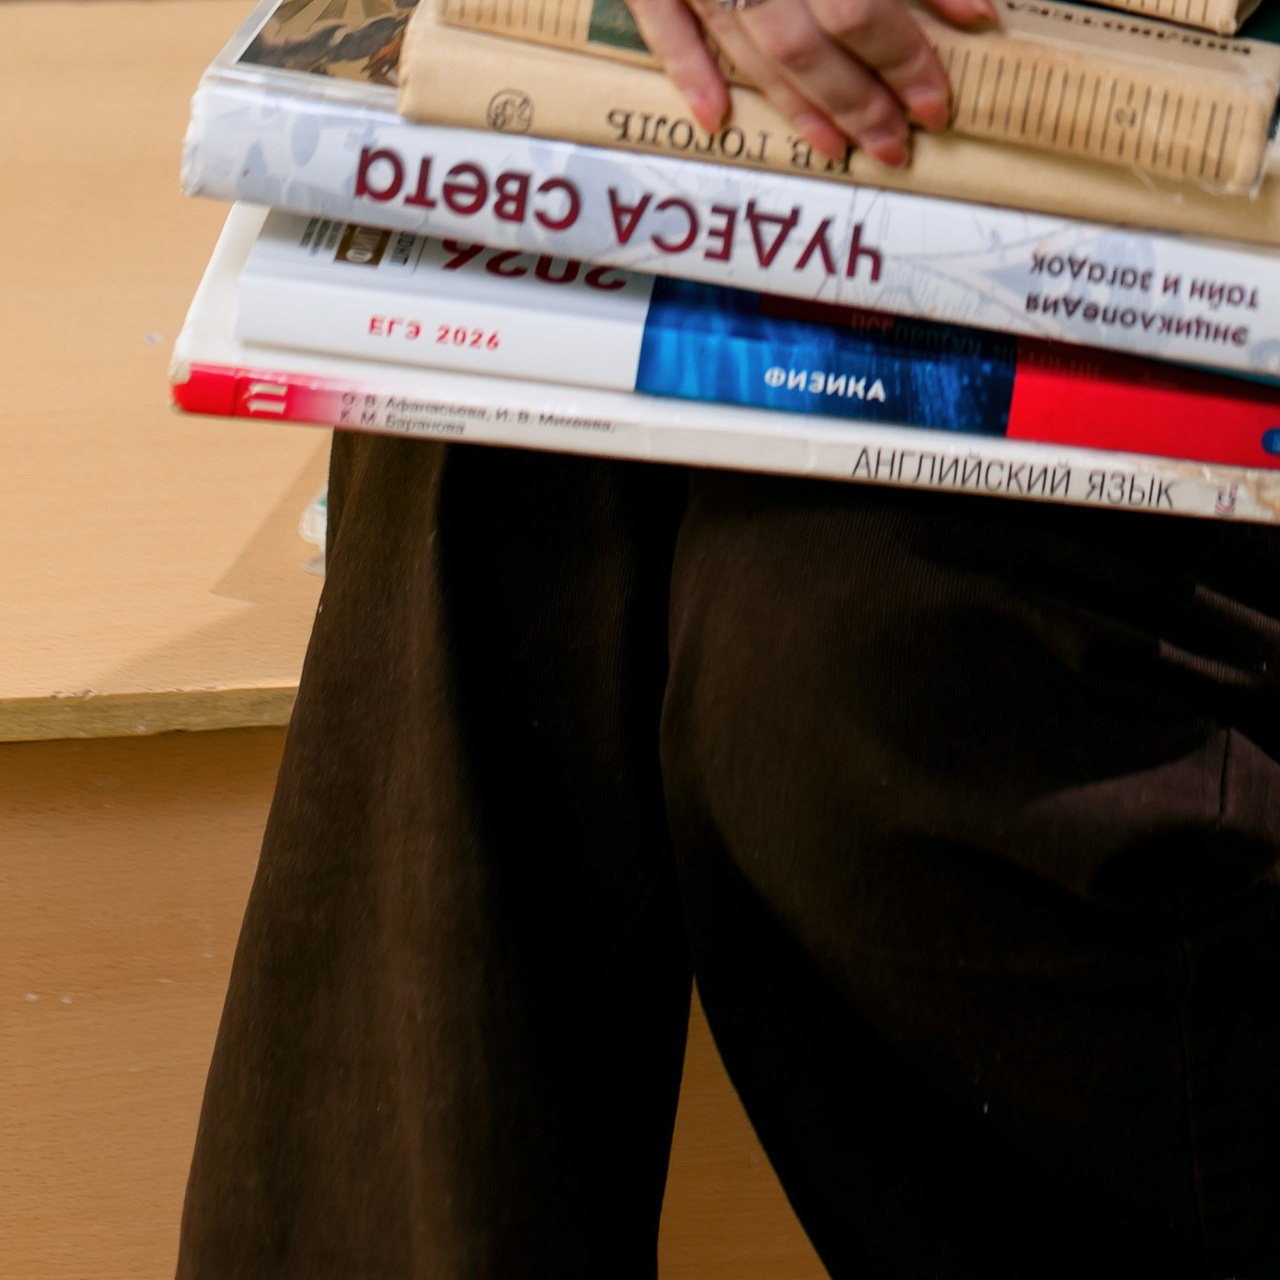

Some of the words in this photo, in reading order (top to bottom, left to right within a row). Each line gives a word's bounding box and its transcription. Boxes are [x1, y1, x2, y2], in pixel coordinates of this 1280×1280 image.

[608, 186, 883, 283] ЧУДЕСА
[369, 315, 422, 340] ЕГЭ
[436, 324, 501, 350] 2026
[764, 367, 887, 403] ФИЗИКА
[851, 446, 1071, 497] АНГЛИЙСКИЙ
[1085, 471, 1175, 510] ЯЗЫК
